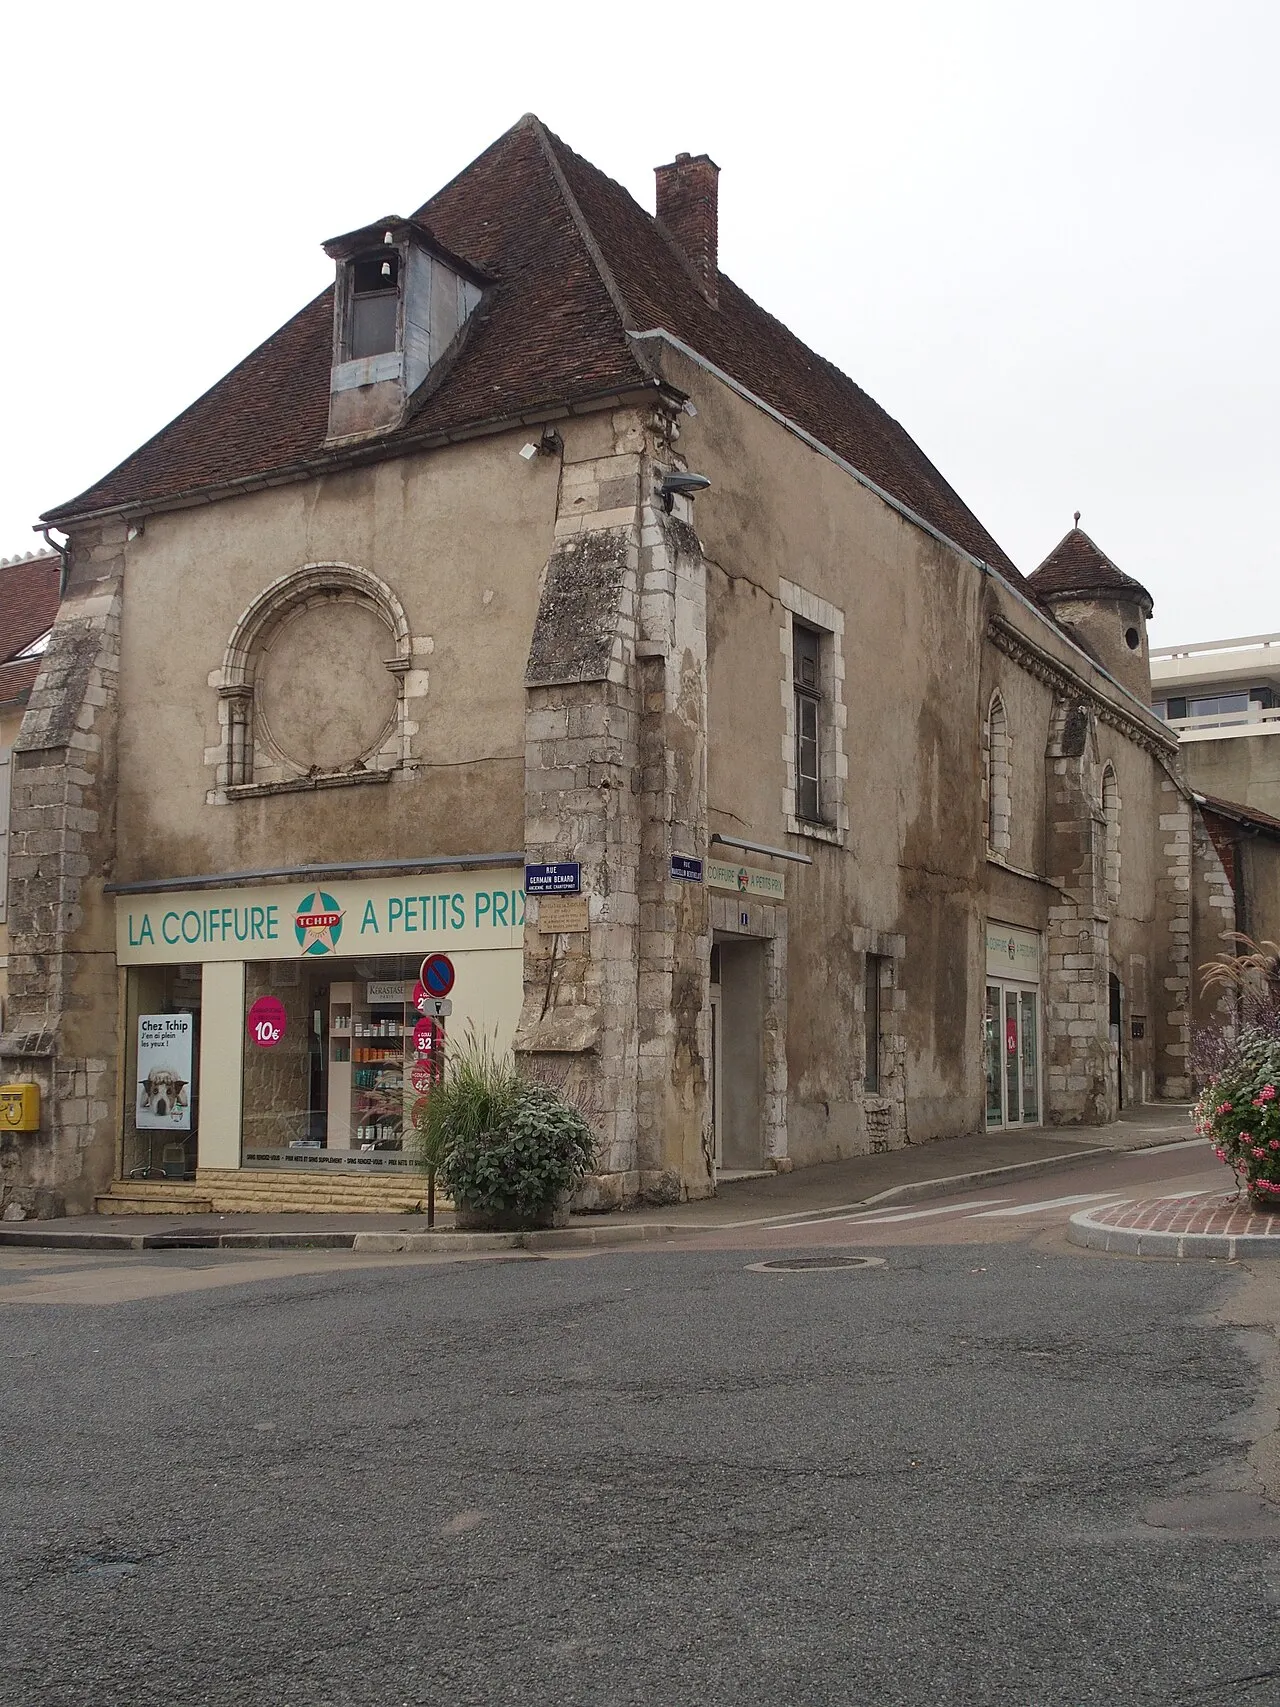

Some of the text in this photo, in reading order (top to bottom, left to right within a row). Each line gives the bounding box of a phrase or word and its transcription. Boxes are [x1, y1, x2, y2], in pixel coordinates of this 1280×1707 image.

[683, 860, 691, 868] RUE
[546, 866, 557, 874] RUE
[707, 865, 735, 884] COIFFURE
[530, 875, 574, 884] GERMAIN BENARD
[360, 900, 380, 934] A
[388, 893, 466, 932] PETITS
[129, 905, 279, 946] LA COIFFURE
[298, 916, 337, 925] TCHIP
[142, 1020, 188, 1033] Chez Tchip
[255, 1021, 280, 1040] 10€
[161, 1031, 176, 1040] plein
